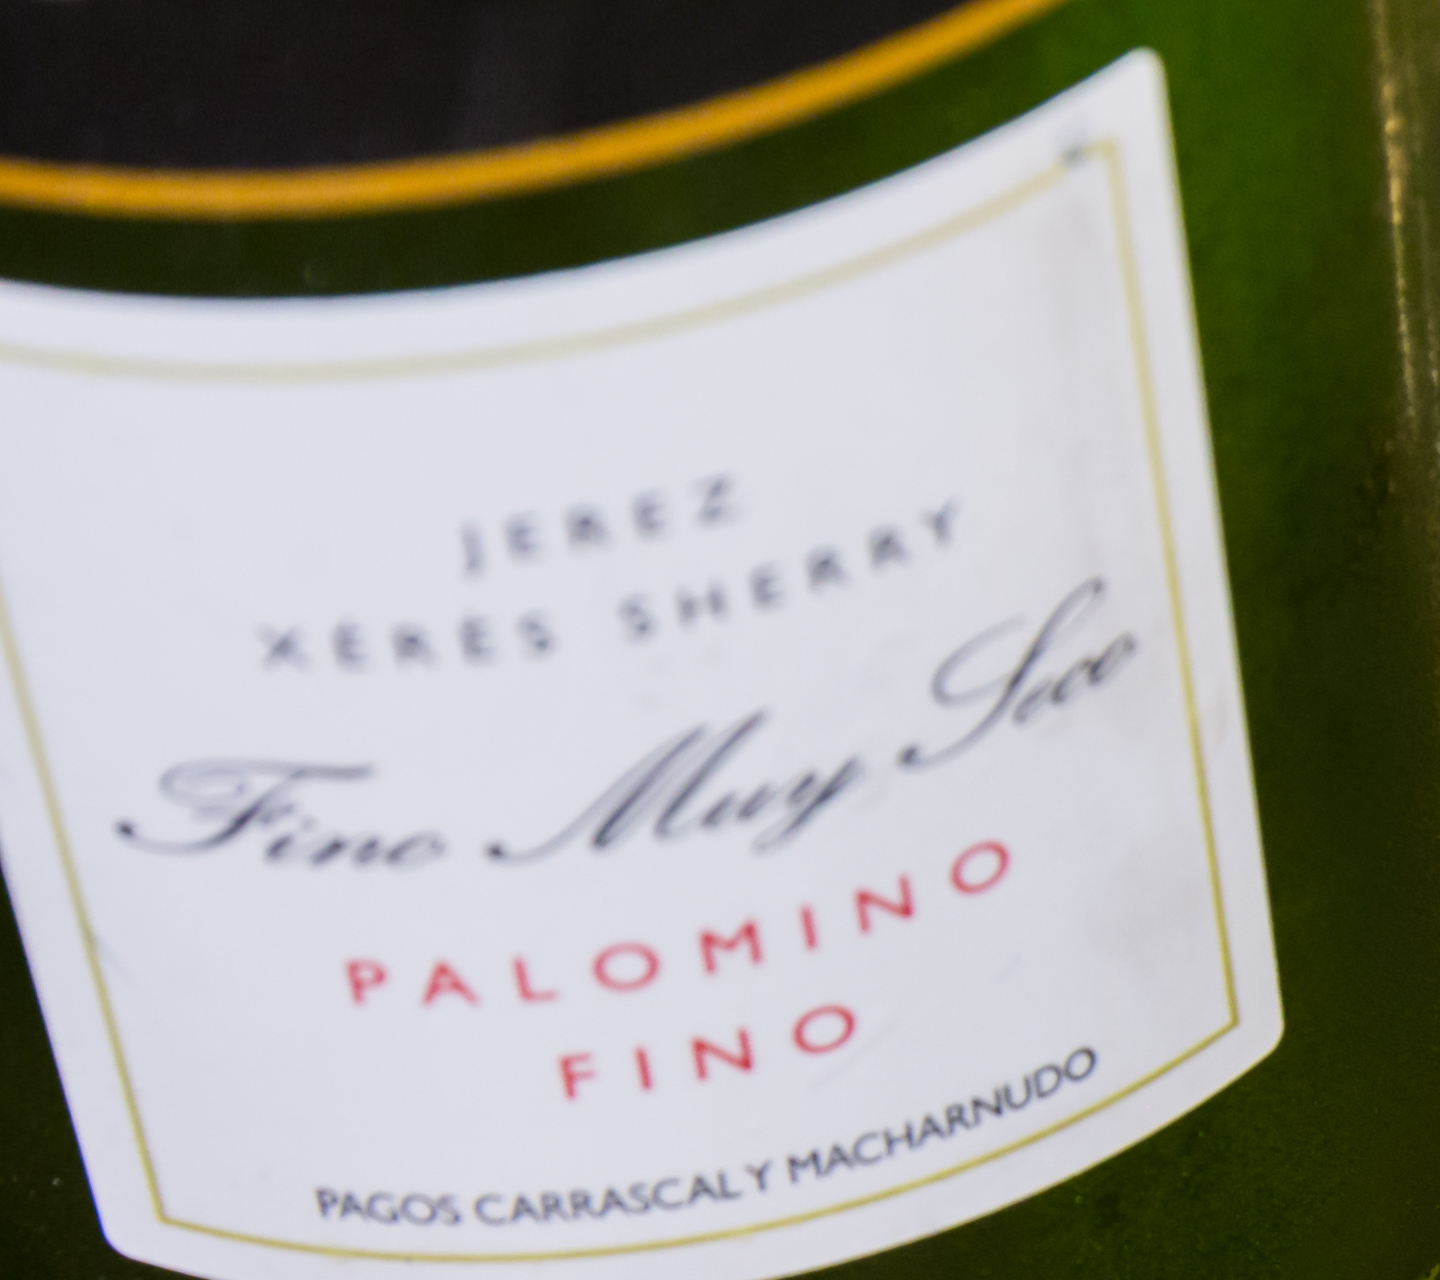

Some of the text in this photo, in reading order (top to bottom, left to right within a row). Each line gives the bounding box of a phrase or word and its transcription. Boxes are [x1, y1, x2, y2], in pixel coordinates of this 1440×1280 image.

[460, 469, 740, 578] JEREZ
[618, 496, 962, 643] SHERRY
[112, 575, 1140, 870] Fino Muy Seco
[343, 838, 1012, 1010] PALOMINO
[558, 1003, 858, 1102] FINO
[313, 1046, 1098, 1227] PAGOS CARRASCAL Y MACHARNUDO
